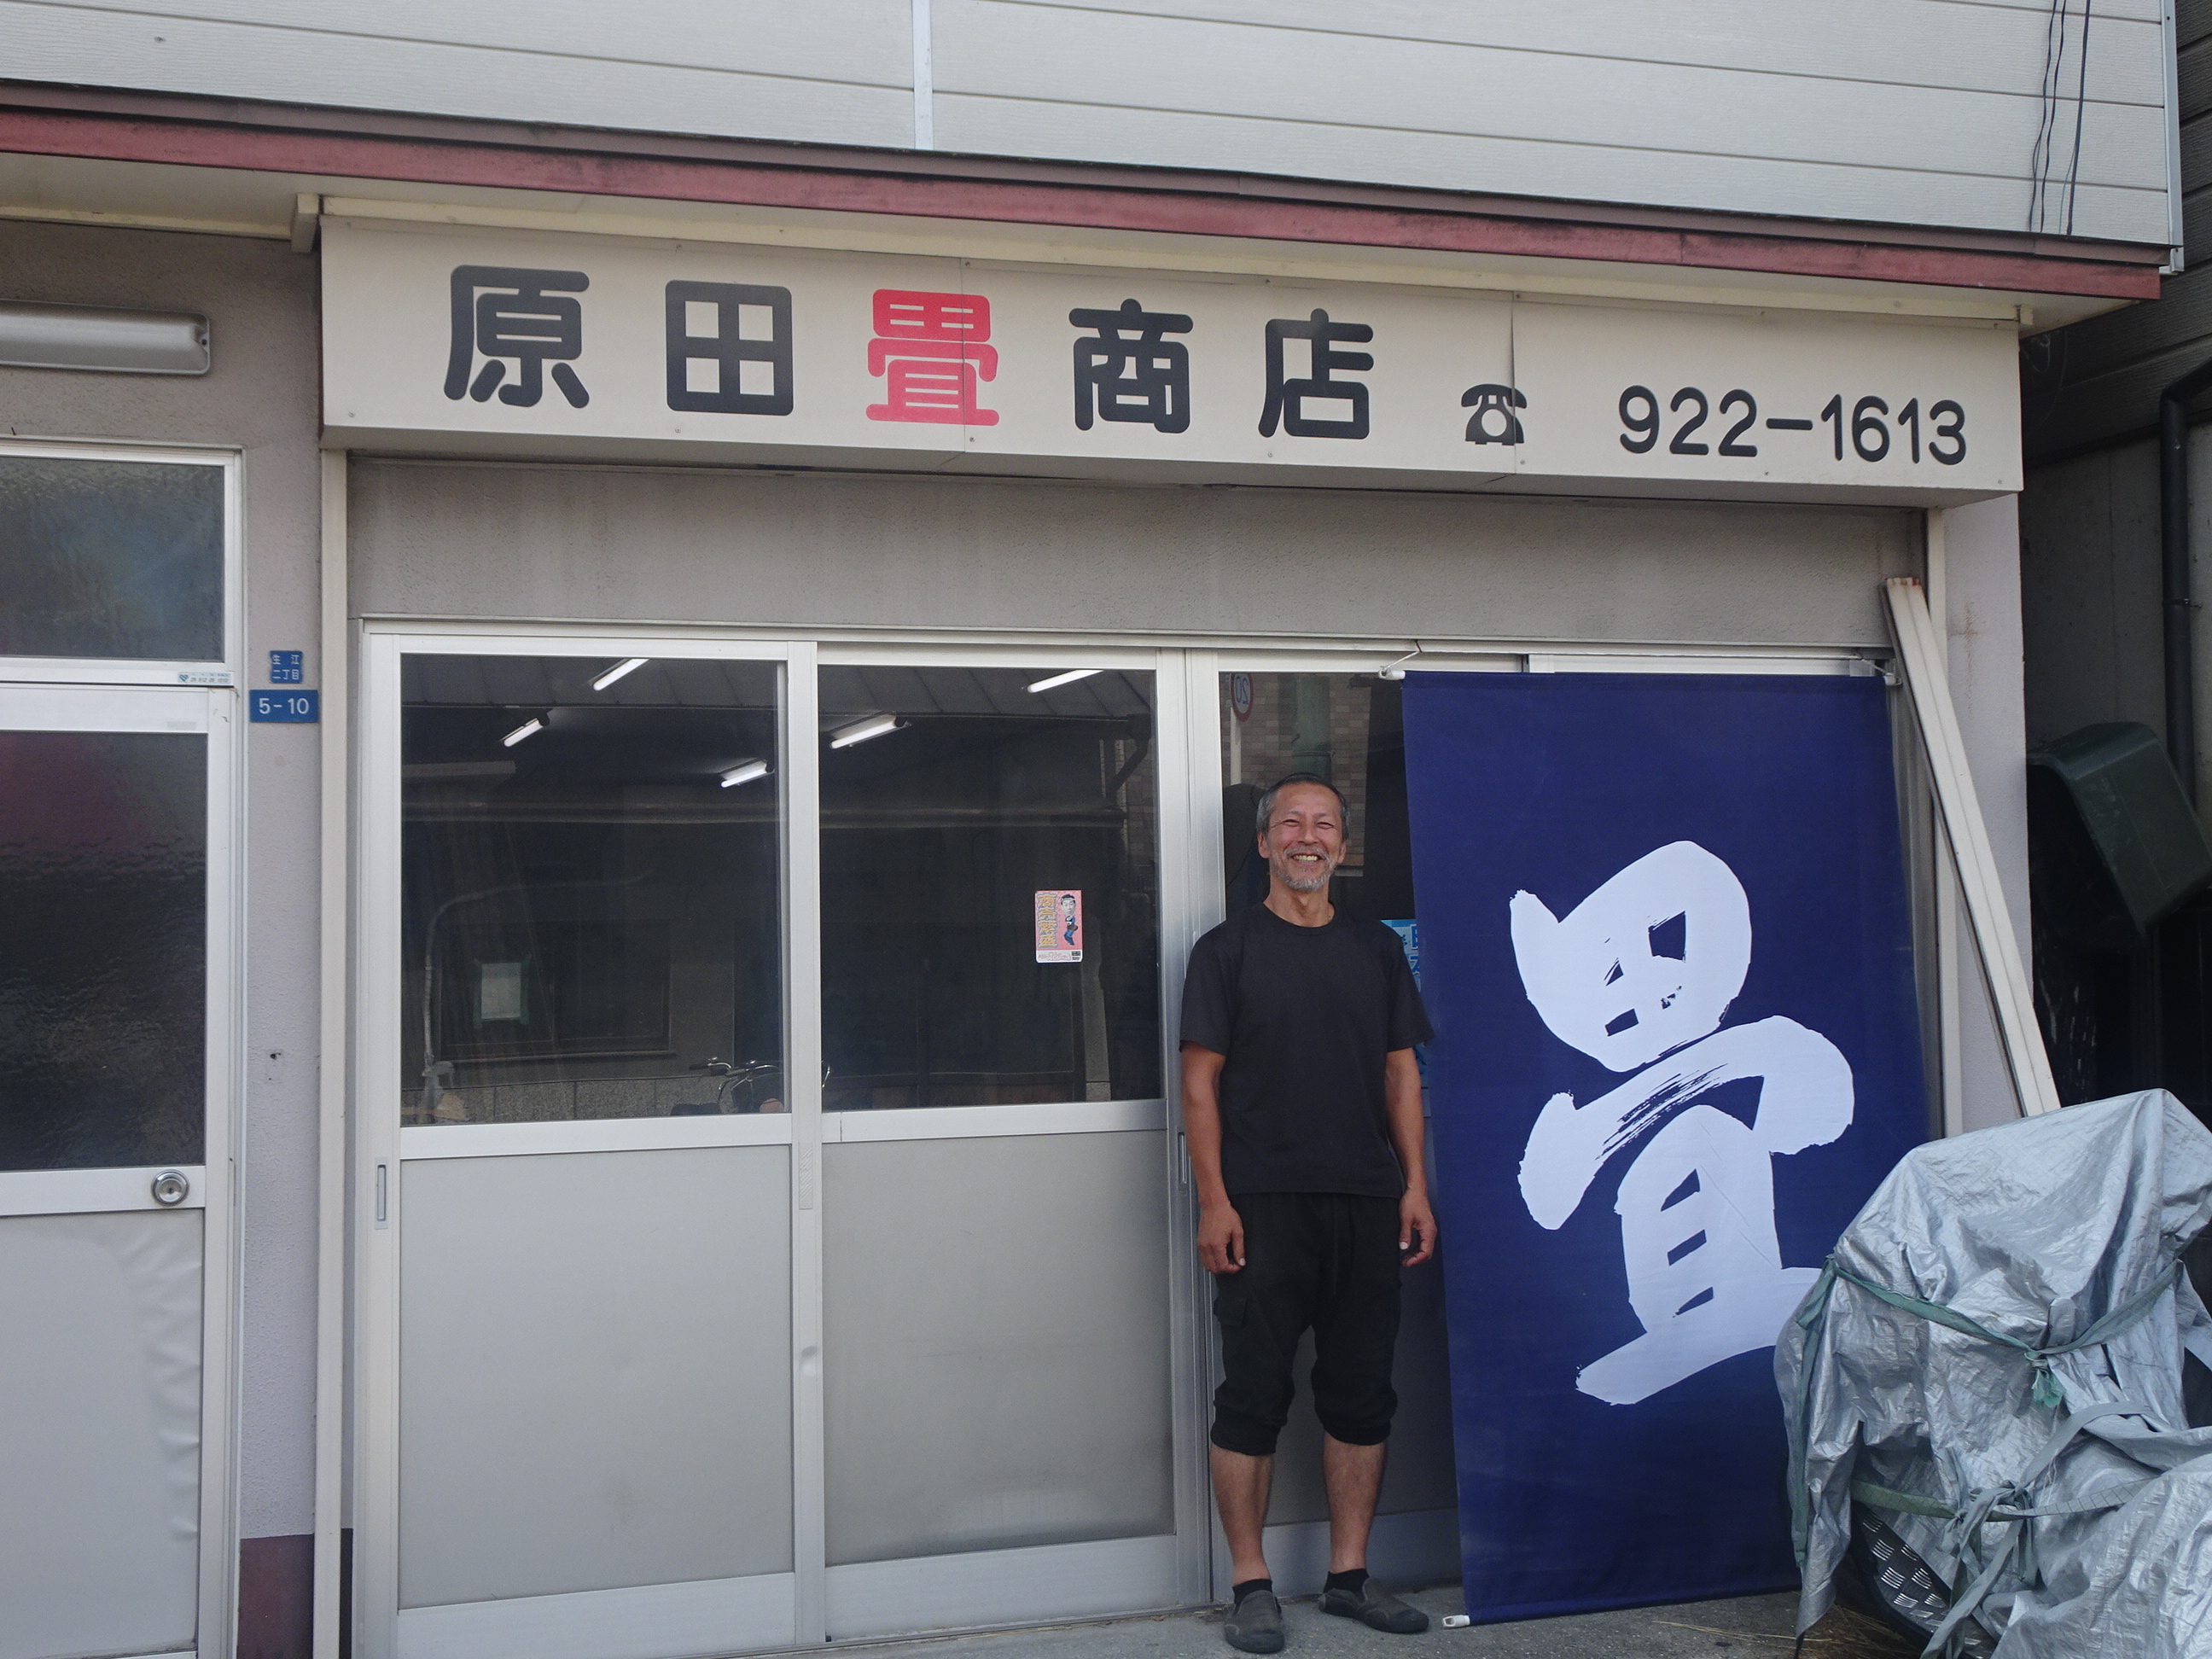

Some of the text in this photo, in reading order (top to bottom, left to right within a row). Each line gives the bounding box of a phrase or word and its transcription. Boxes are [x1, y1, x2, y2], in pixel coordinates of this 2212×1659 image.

[443, 265, 1375, 440] 原田畳商店
[1618, 385, 1967, 466] 922-1613
[259, 697, 309, 714] 5-10
[272, 668, 300, 680] 二丁目
[1510, 840, 1855, 1406] 畳
